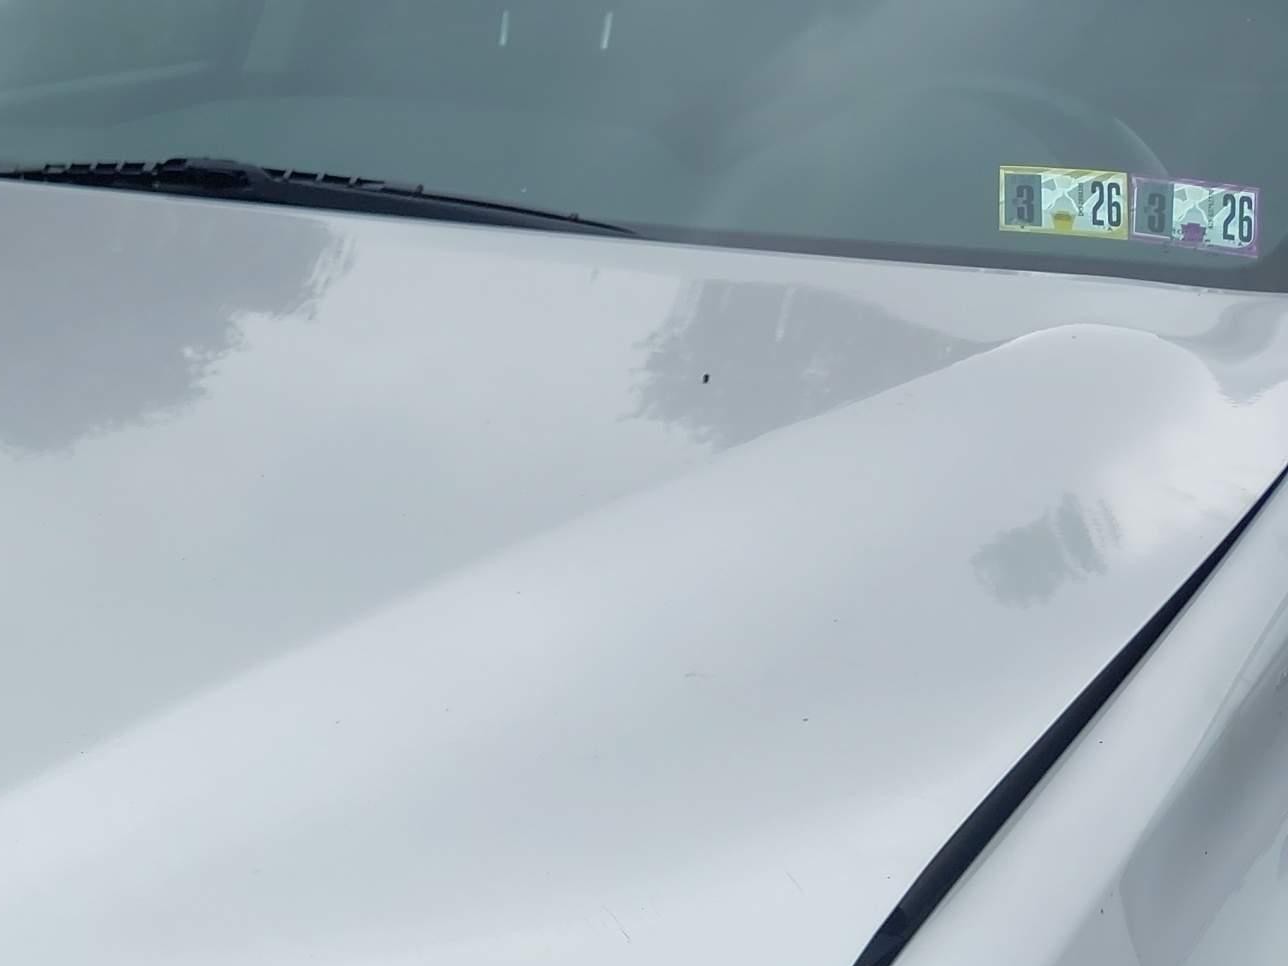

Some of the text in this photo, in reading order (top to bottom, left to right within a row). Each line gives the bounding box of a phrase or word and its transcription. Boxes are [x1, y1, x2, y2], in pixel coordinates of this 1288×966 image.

[1015, 184, 1034, 224] 3
[1091, 180, 1122, 227] 26
[1147, 192, 1166, 233] 3
[1222, 193, 1253, 243] 26
